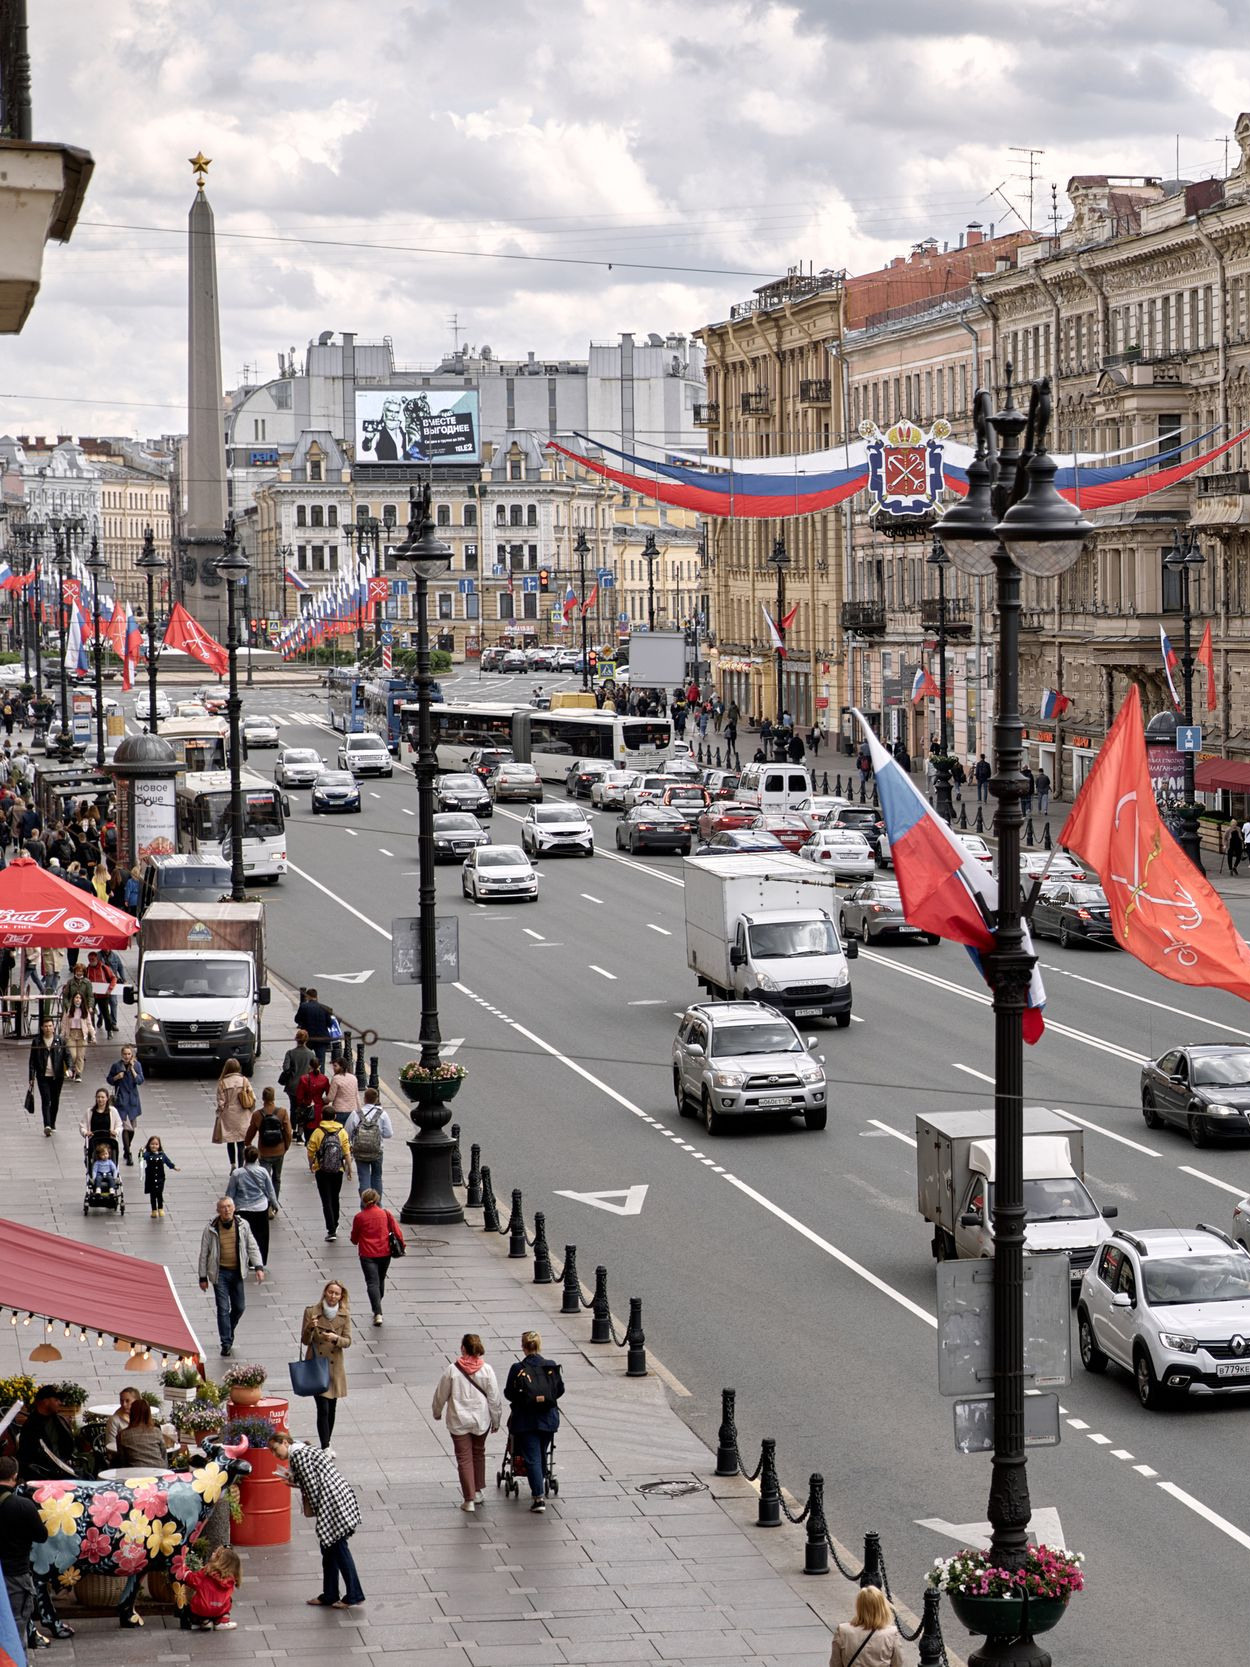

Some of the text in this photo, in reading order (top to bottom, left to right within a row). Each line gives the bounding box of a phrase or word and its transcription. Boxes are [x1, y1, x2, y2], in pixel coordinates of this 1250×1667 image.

[423, 416, 457, 426] ВМЕСТЕ
[423, 424, 470, 435] ВЫГОДНЕЕ
[455, 443, 473, 452] TELE2
[137, 784, 168, 792] новое
